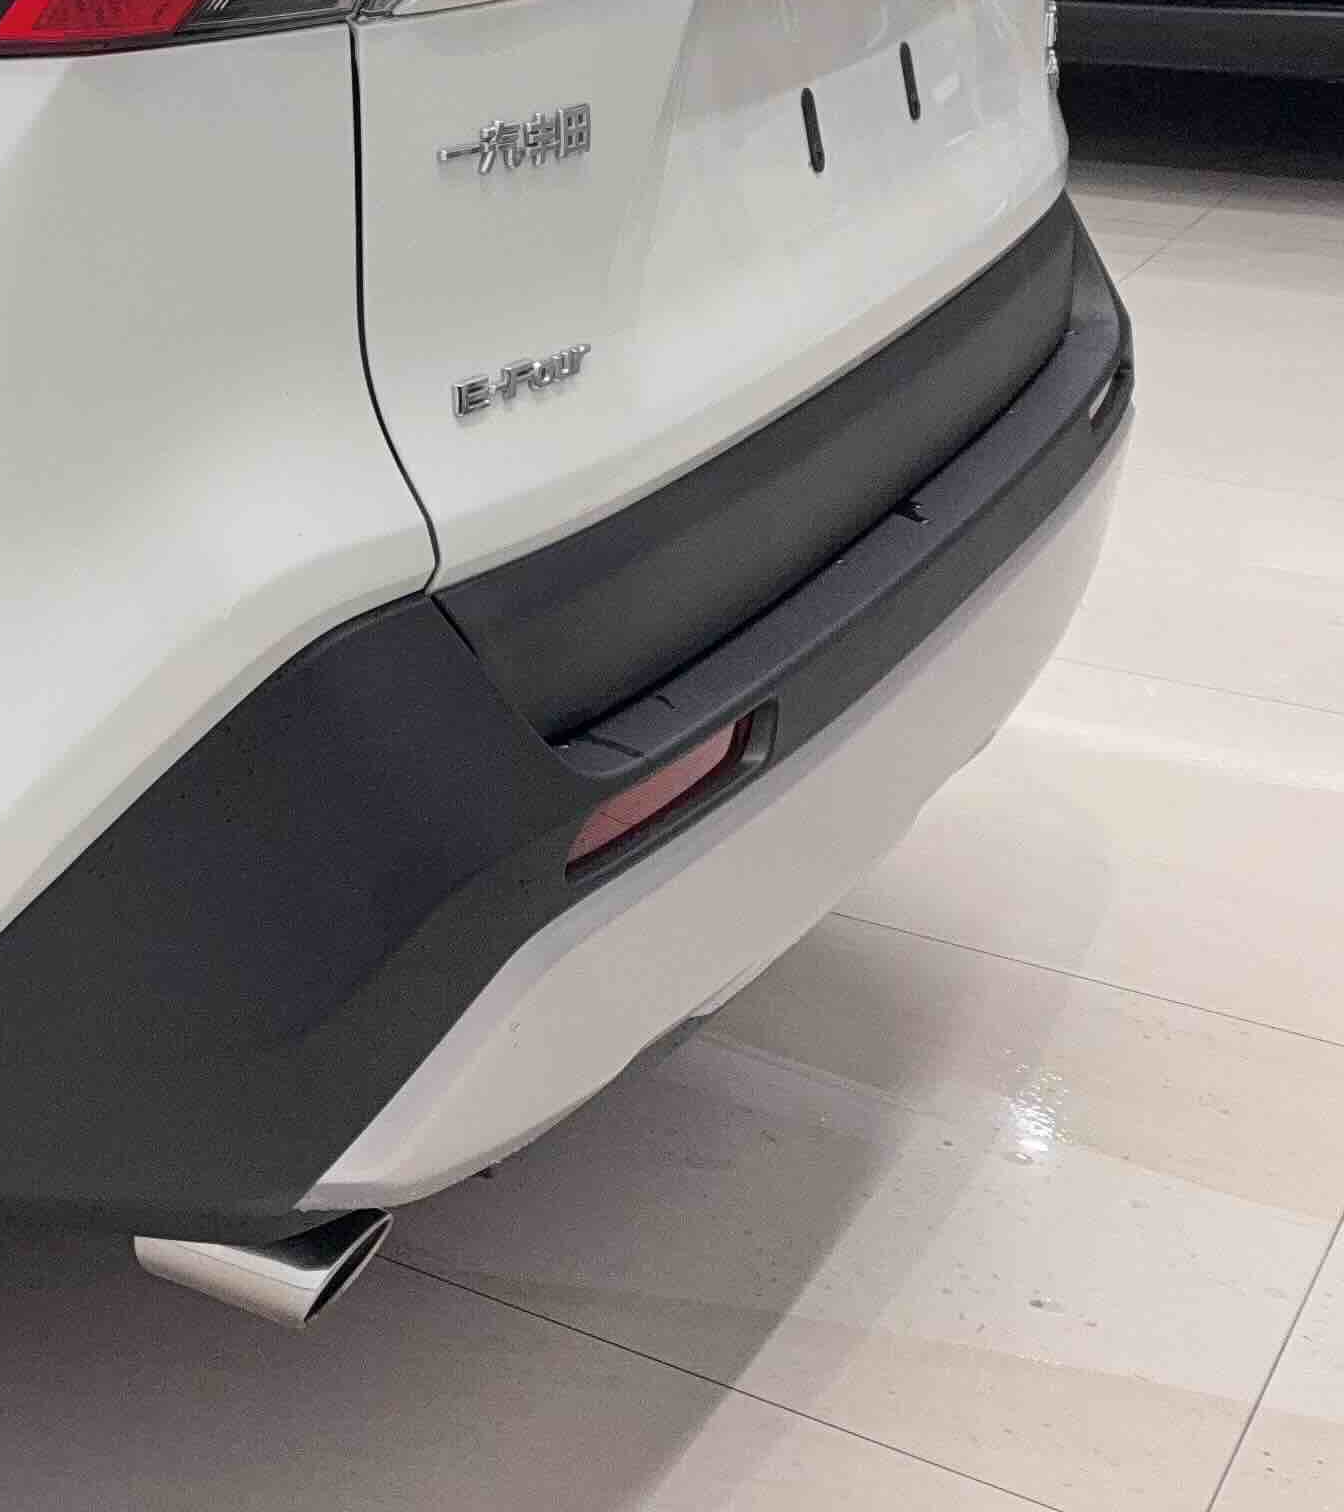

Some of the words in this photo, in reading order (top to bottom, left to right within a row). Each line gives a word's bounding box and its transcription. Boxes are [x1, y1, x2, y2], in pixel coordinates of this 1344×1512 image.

[437, 102, 592, 175] 一汽丰田
[451, 343, 592, 417] E-Four
